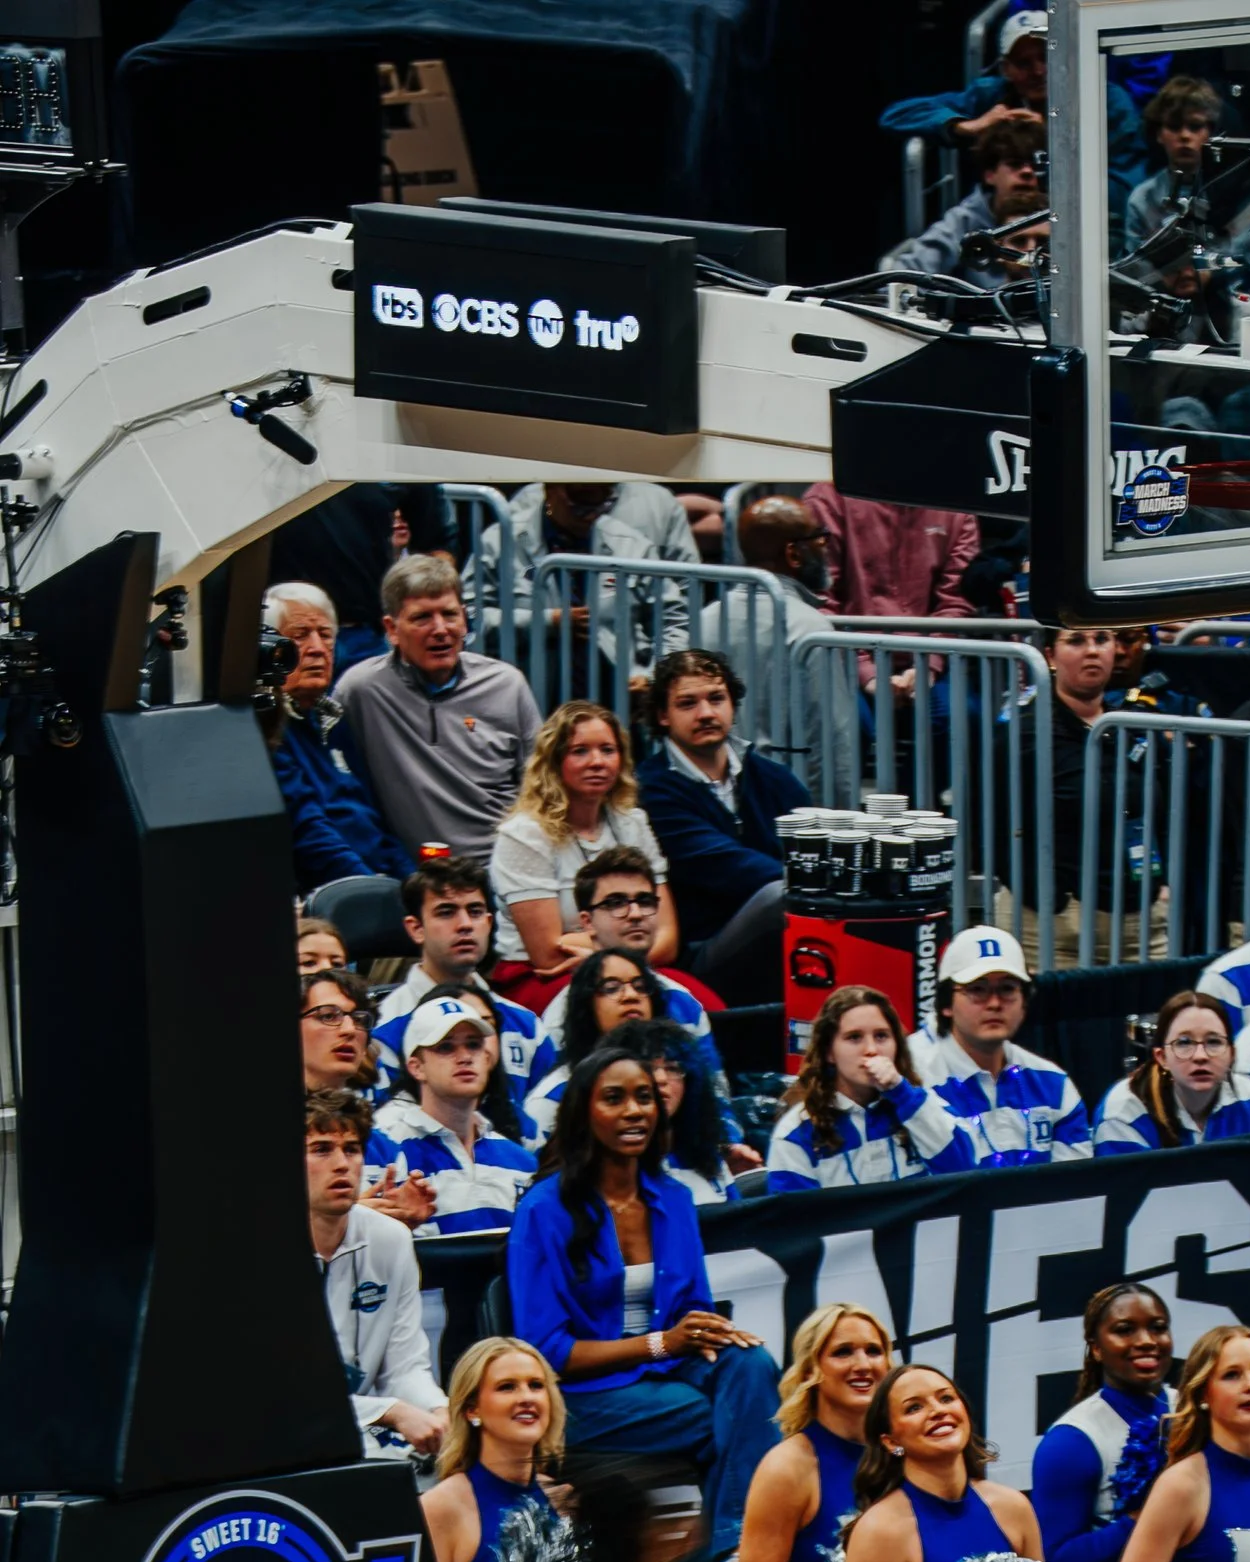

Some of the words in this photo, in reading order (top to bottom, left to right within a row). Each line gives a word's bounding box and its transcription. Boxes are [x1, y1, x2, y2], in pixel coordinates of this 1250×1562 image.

[460, 298, 520, 338] CBS
[1133, 482, 1171, 500] MARCH
[1136, 494, 1187, 514] MADNESS
[978, 939, 1001, 958] D
[918, 922, 937, 1029] YARMOR
[440, 1001, 464, 1016] D
[190, 1518, 251, 1560] SWEET
[255, 1518, 285, 1546] 16
